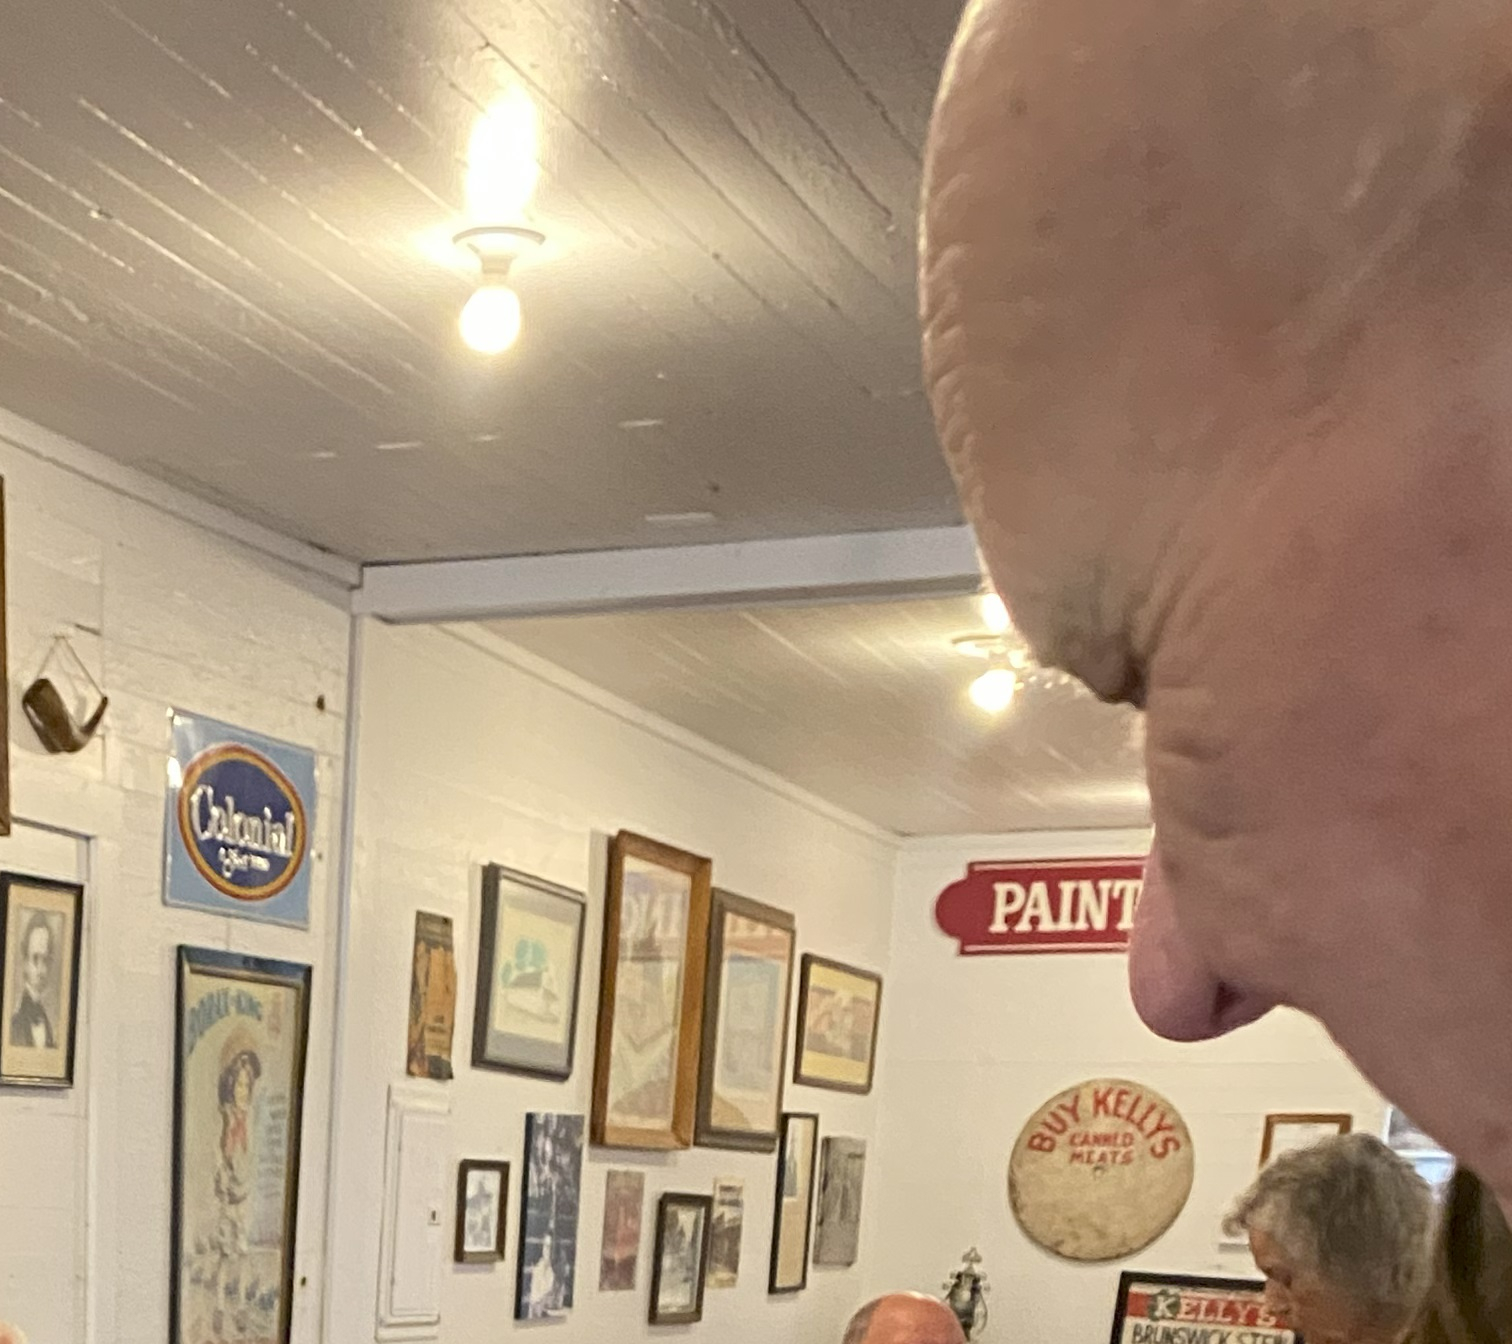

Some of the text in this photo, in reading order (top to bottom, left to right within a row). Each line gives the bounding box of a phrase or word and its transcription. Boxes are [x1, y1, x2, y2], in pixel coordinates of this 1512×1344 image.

[190, 783, 295, 858] Colonial
[989, 880, 1144, 933] PAINT
[1028, 1094, 1080, 1153] BUY
[1069, 1132, 1135, 1147] CANNED
[1069, 1150, 1135, 1165] MEATS
